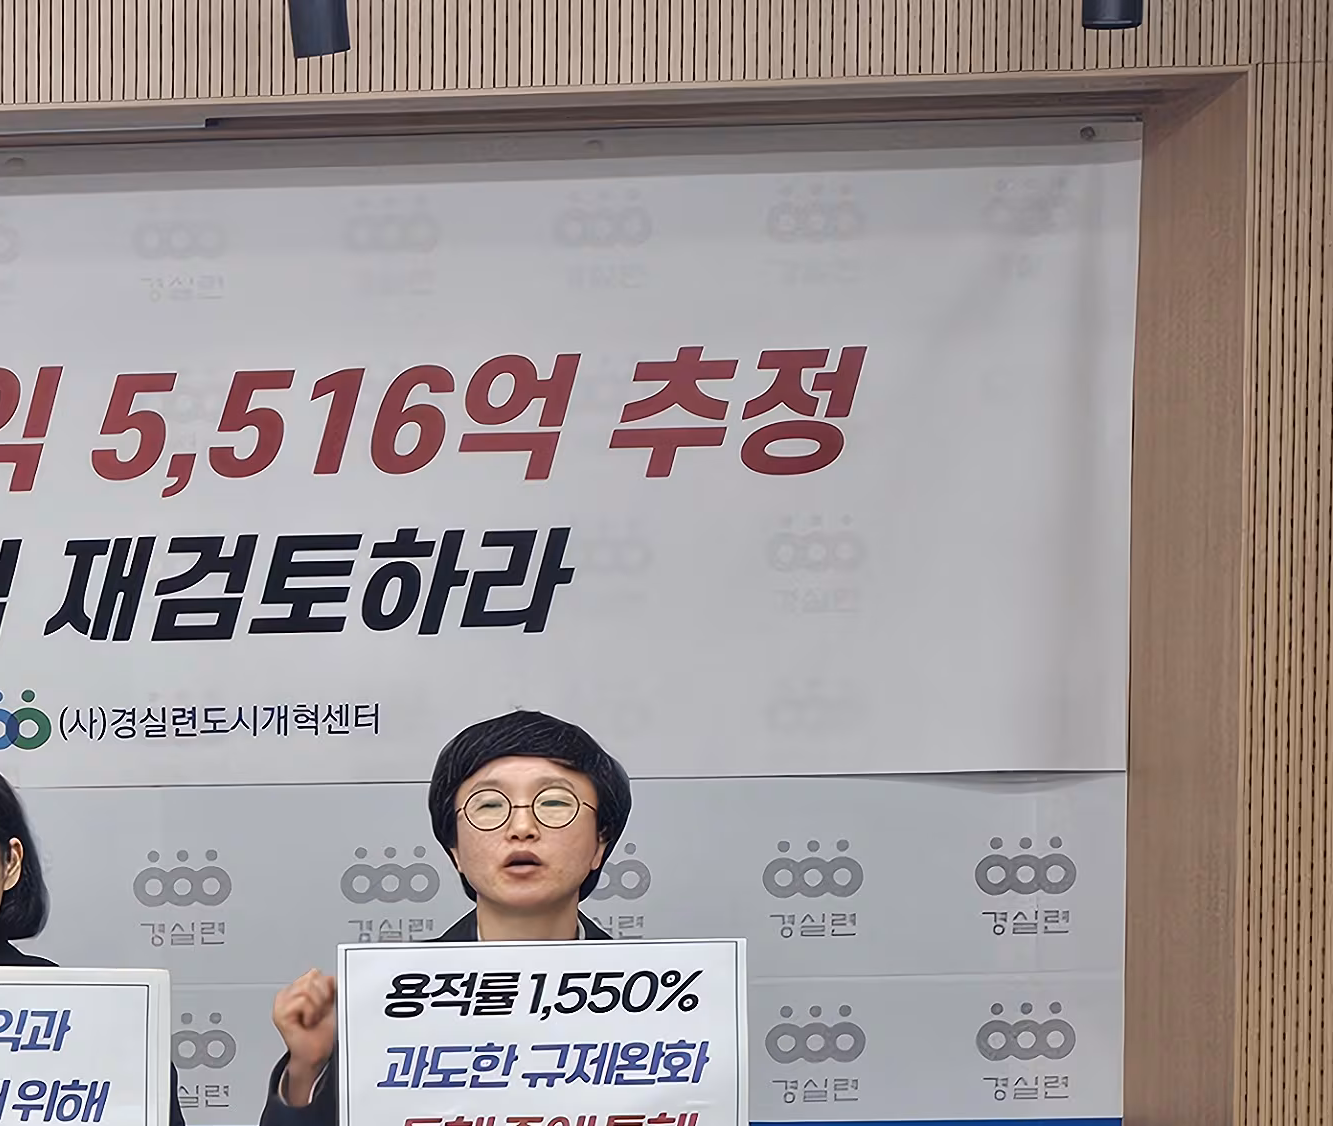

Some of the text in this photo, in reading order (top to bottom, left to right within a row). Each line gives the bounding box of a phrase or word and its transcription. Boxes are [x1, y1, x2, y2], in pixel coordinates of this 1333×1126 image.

[91, 352, 582, 499] 5,516억
[608, 345, 868, 479] 추정
[43, 526, 576, 642] 재검토하라
[59, 702, 379, 742] (사)경실련도시개혁센터
[140, 921, 226, 947] 경실련
[348, 917, 434, 943] 경실련
[770, 912, 857, 938] 경실련
[981, 909, 1070, 936] 경실련
[383, 969, 704, 1022] 용적률 1,550%
[376, 1039, 711, 1089] 과도한 규제완화
[11, 1079, 111, 1123] 위해
[180, 1083, 230, 1108] 실련
[772, 1078, 859, 1103] 경실련
[983, 1075, 1069, 1101] 경실련
